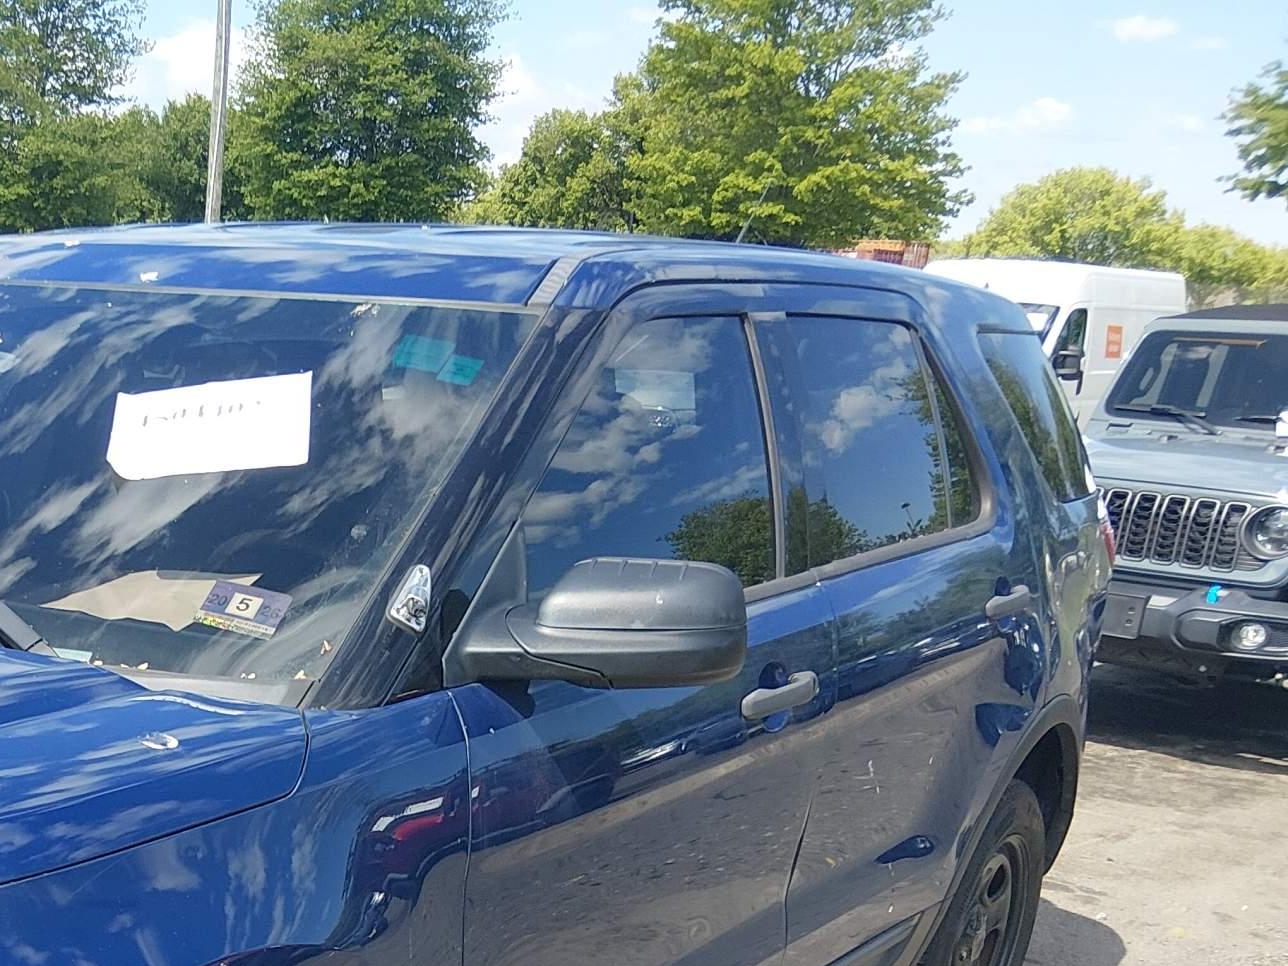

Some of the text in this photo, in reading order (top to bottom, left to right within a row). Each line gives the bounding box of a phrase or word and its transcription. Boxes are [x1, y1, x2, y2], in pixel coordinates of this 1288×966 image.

[207, 593, 282, 619] 20 5 26
